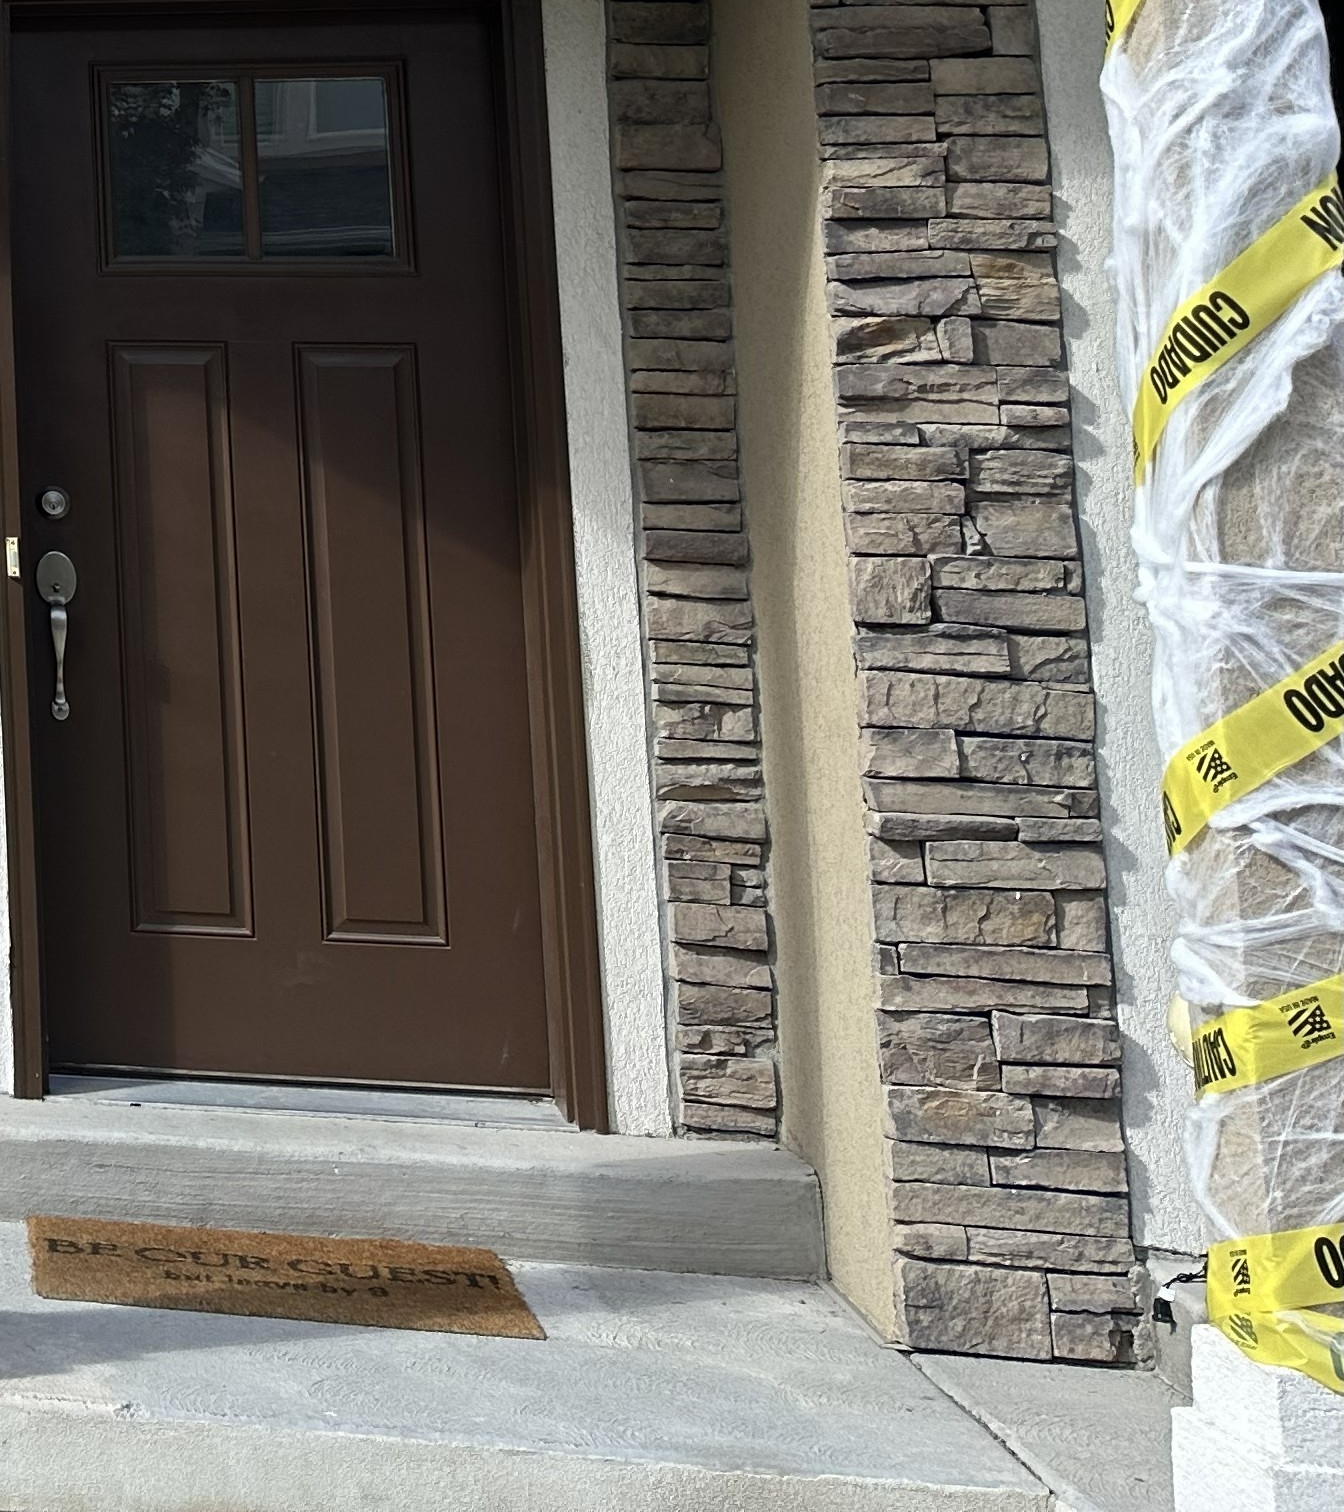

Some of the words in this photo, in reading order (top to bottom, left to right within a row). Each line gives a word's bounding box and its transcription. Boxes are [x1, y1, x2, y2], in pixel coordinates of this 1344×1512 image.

[1150, 291, 1251, 405] CUIDADO
[1284, 653, 1344, 733] ADO
[44, 1238, 123, 1257] BE
[135, 1247, 270, 1269] OUR
